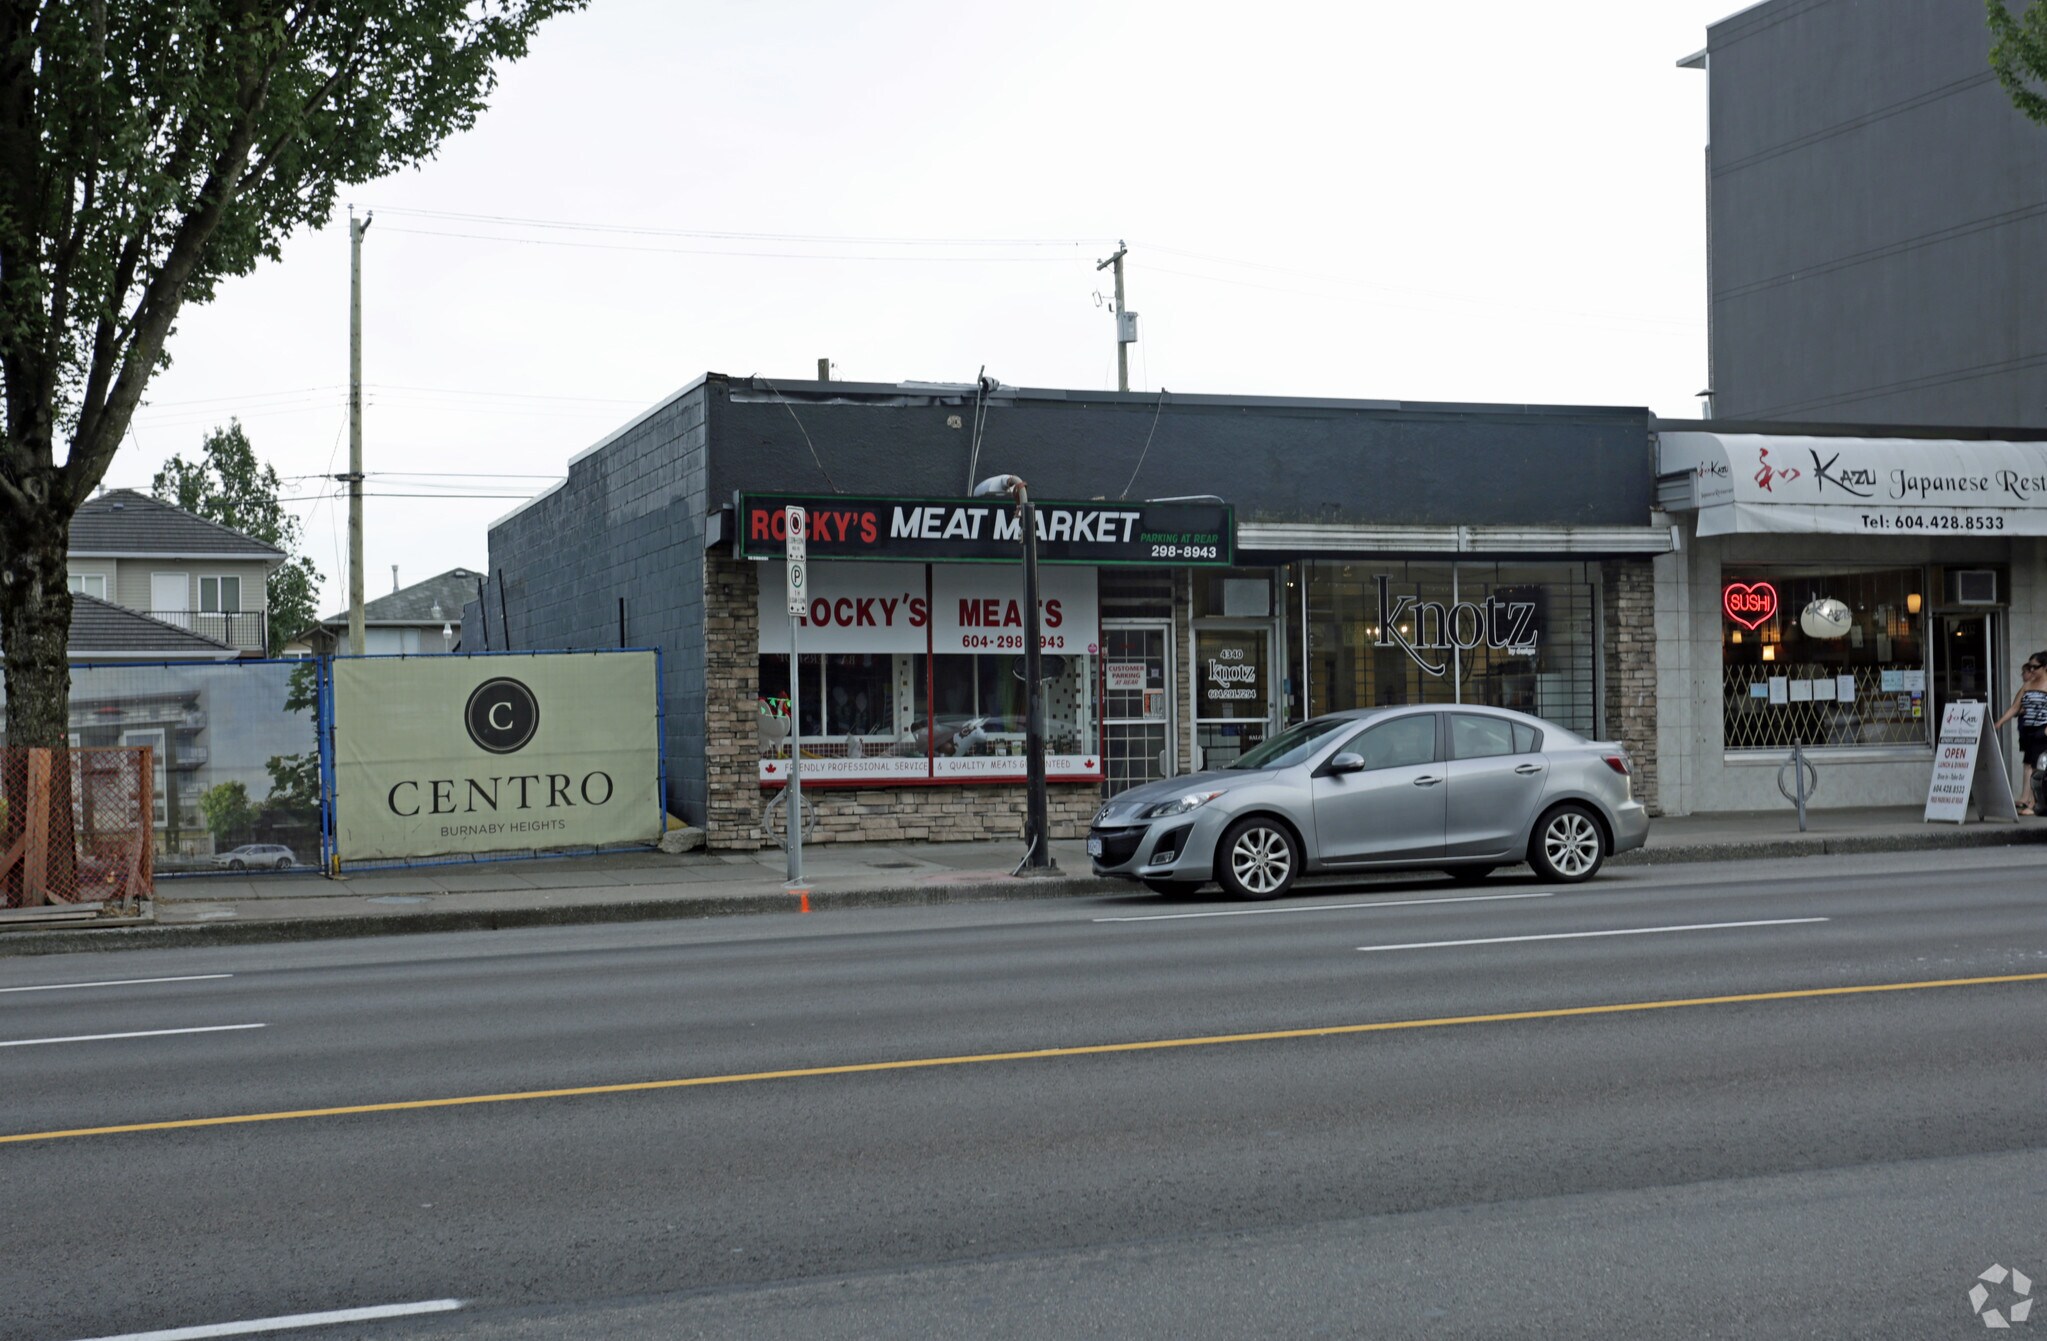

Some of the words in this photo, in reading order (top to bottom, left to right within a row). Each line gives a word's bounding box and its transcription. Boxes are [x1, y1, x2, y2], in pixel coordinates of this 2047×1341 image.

[1889, 469, 1989, 500] Japanese
[752, 509, 877, 543] ROKY'S
[890, 506, 988, 539] MEAT
[1861, 515, 1890, 528] Tel:
[1895, 515, 2004, 530] 604.428.8533
[1140, 533, 1178, 543] PARKING
[1181, 534, 1191, 544] AT
[1194, 534, 1218, 544] REAR
[1151, 545, 1217, 558] 298-8943
[798, 593, 927, 627] OCKY'S
[959, 599, 1062, 628] MEAS
[1730, 594, 1770, 612] SUSHI
[1373, 574, 1538, 677] knotz
[962, 635, 1064, 648] 604-298943
[1220, 649, 1243, 659] 4340
[1208, 659, 1256, 688] knotz
[488, 702, 514, 730] C
[1944, 748, 1967, 759] OPEN
[828, 762, 889, 771] PROFESSIONAL
[895, 761, 928, 770] SERVICE
[950, 761, 985, 770] QUALITY
[990, 760, 1017, 769] MEATS
[388, 771, 614, 816] CENTRO
[441, 823, 505, 837] BURNABY
[510, 819, 566, 833] HEIGHTS
